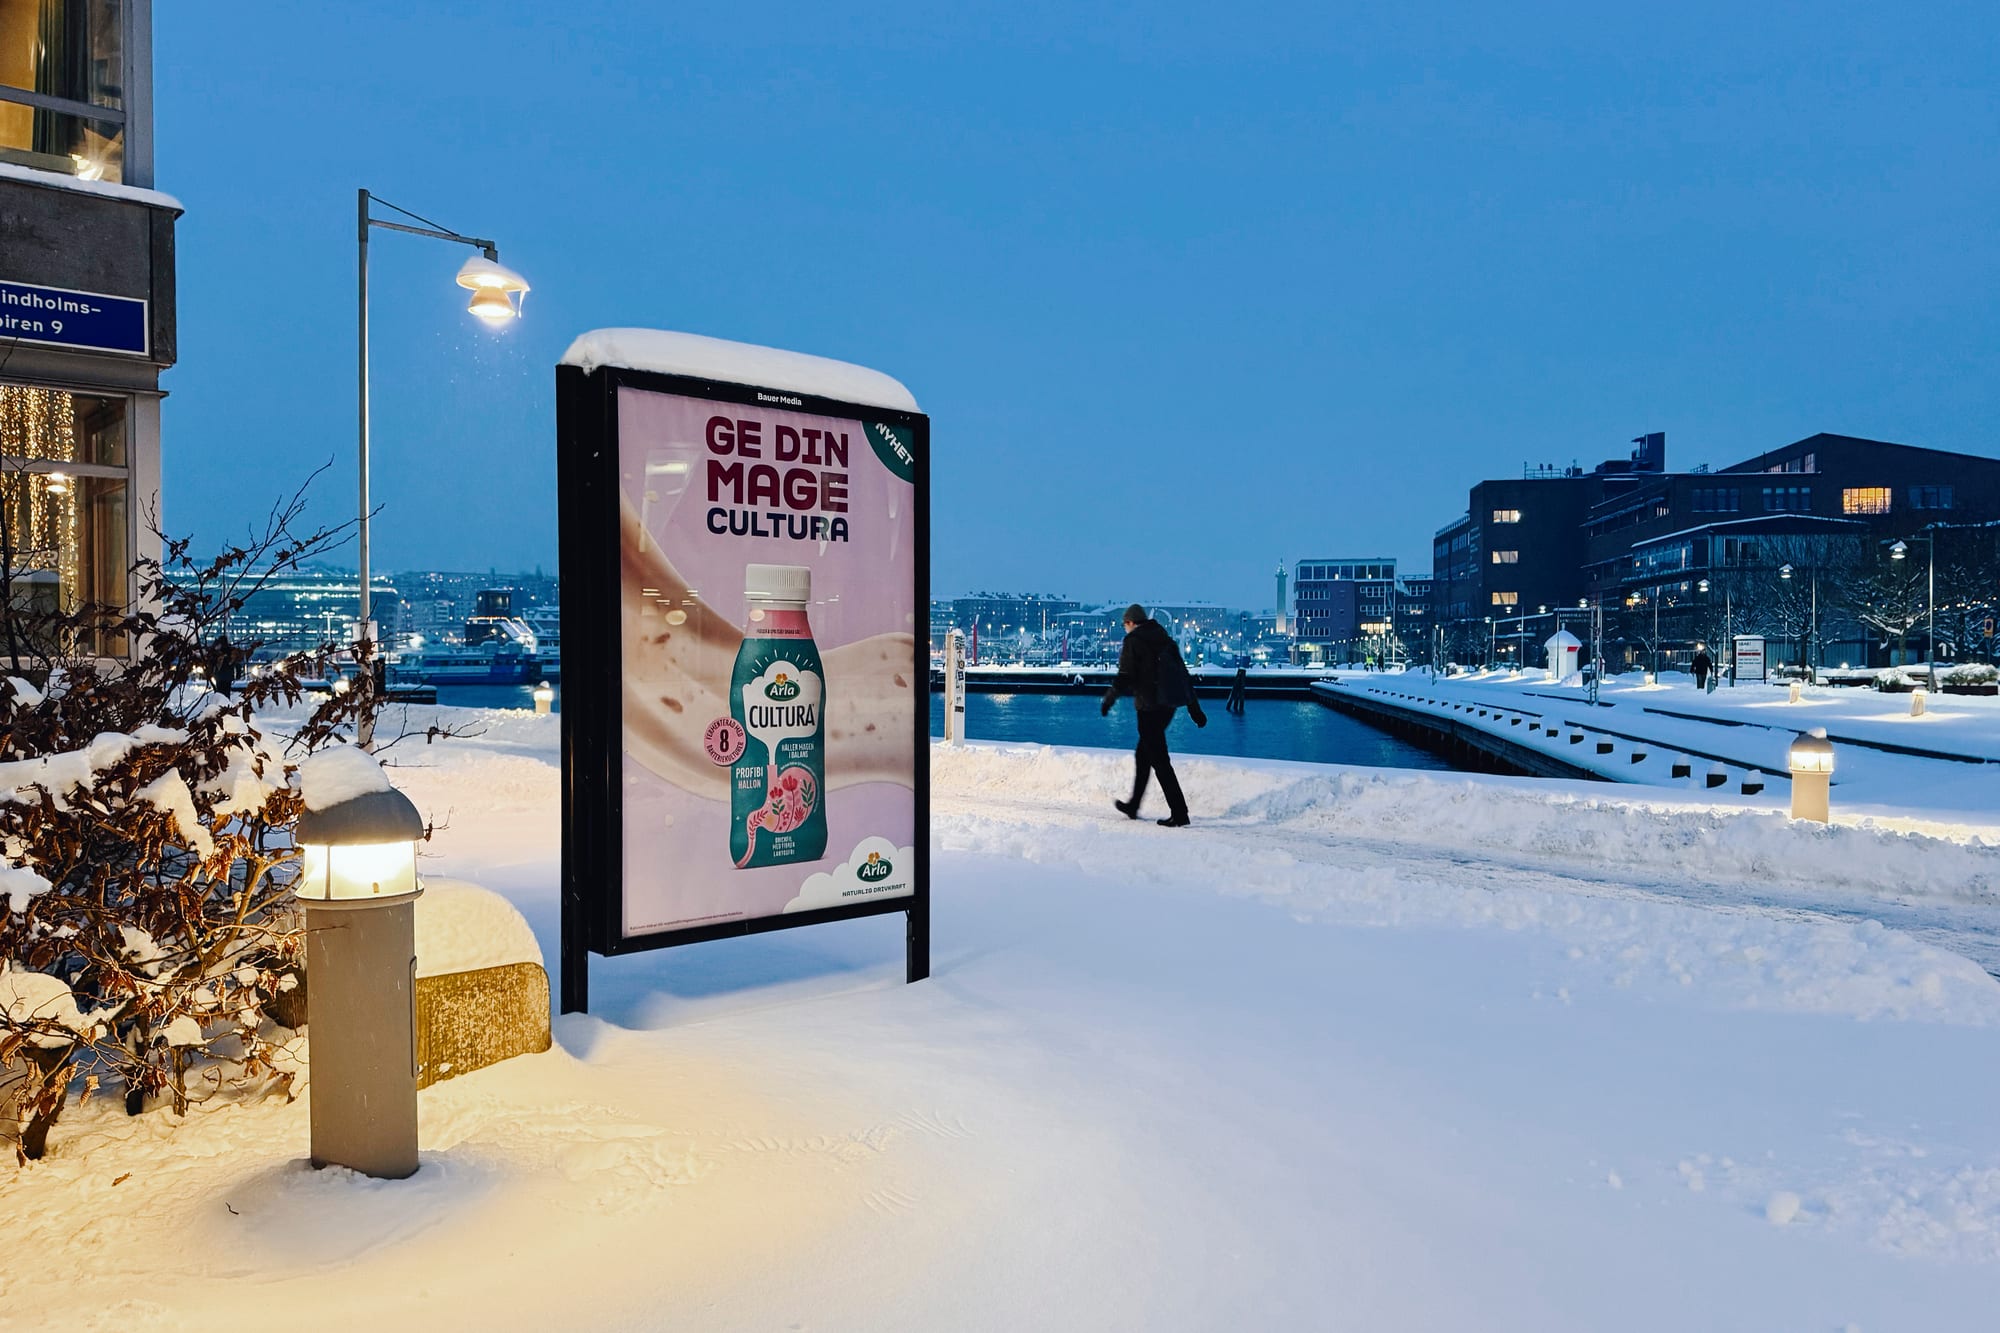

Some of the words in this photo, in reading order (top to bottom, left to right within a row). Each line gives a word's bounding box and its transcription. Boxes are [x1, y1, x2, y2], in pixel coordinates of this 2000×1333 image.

[51, 320, 63, 334] 9
[757, 392, 779, 403] Bauer
[780, 396, 802, 406] Media
[706, 415, 762, 459] GE
[775, 424, 849, 468] DIN
[875, 422, 914, 466] NYHET
[707, 459, 849, 513] MAGE
[707, 507, 849, 543] CULTURA
[769, 684, 795, 696] Arla
[750, 705, 816, 728] CULTURA
[719, 729, 729, 753] 8
[735, 766, 764, 779] PROFIBI
[738, 779, 761, 790] HALLON
[862, 863, 887, 878] Arla
[842, 887, 872, 897] NATURLIG
[873, 882, 906, 894] DRIVKRAFT
